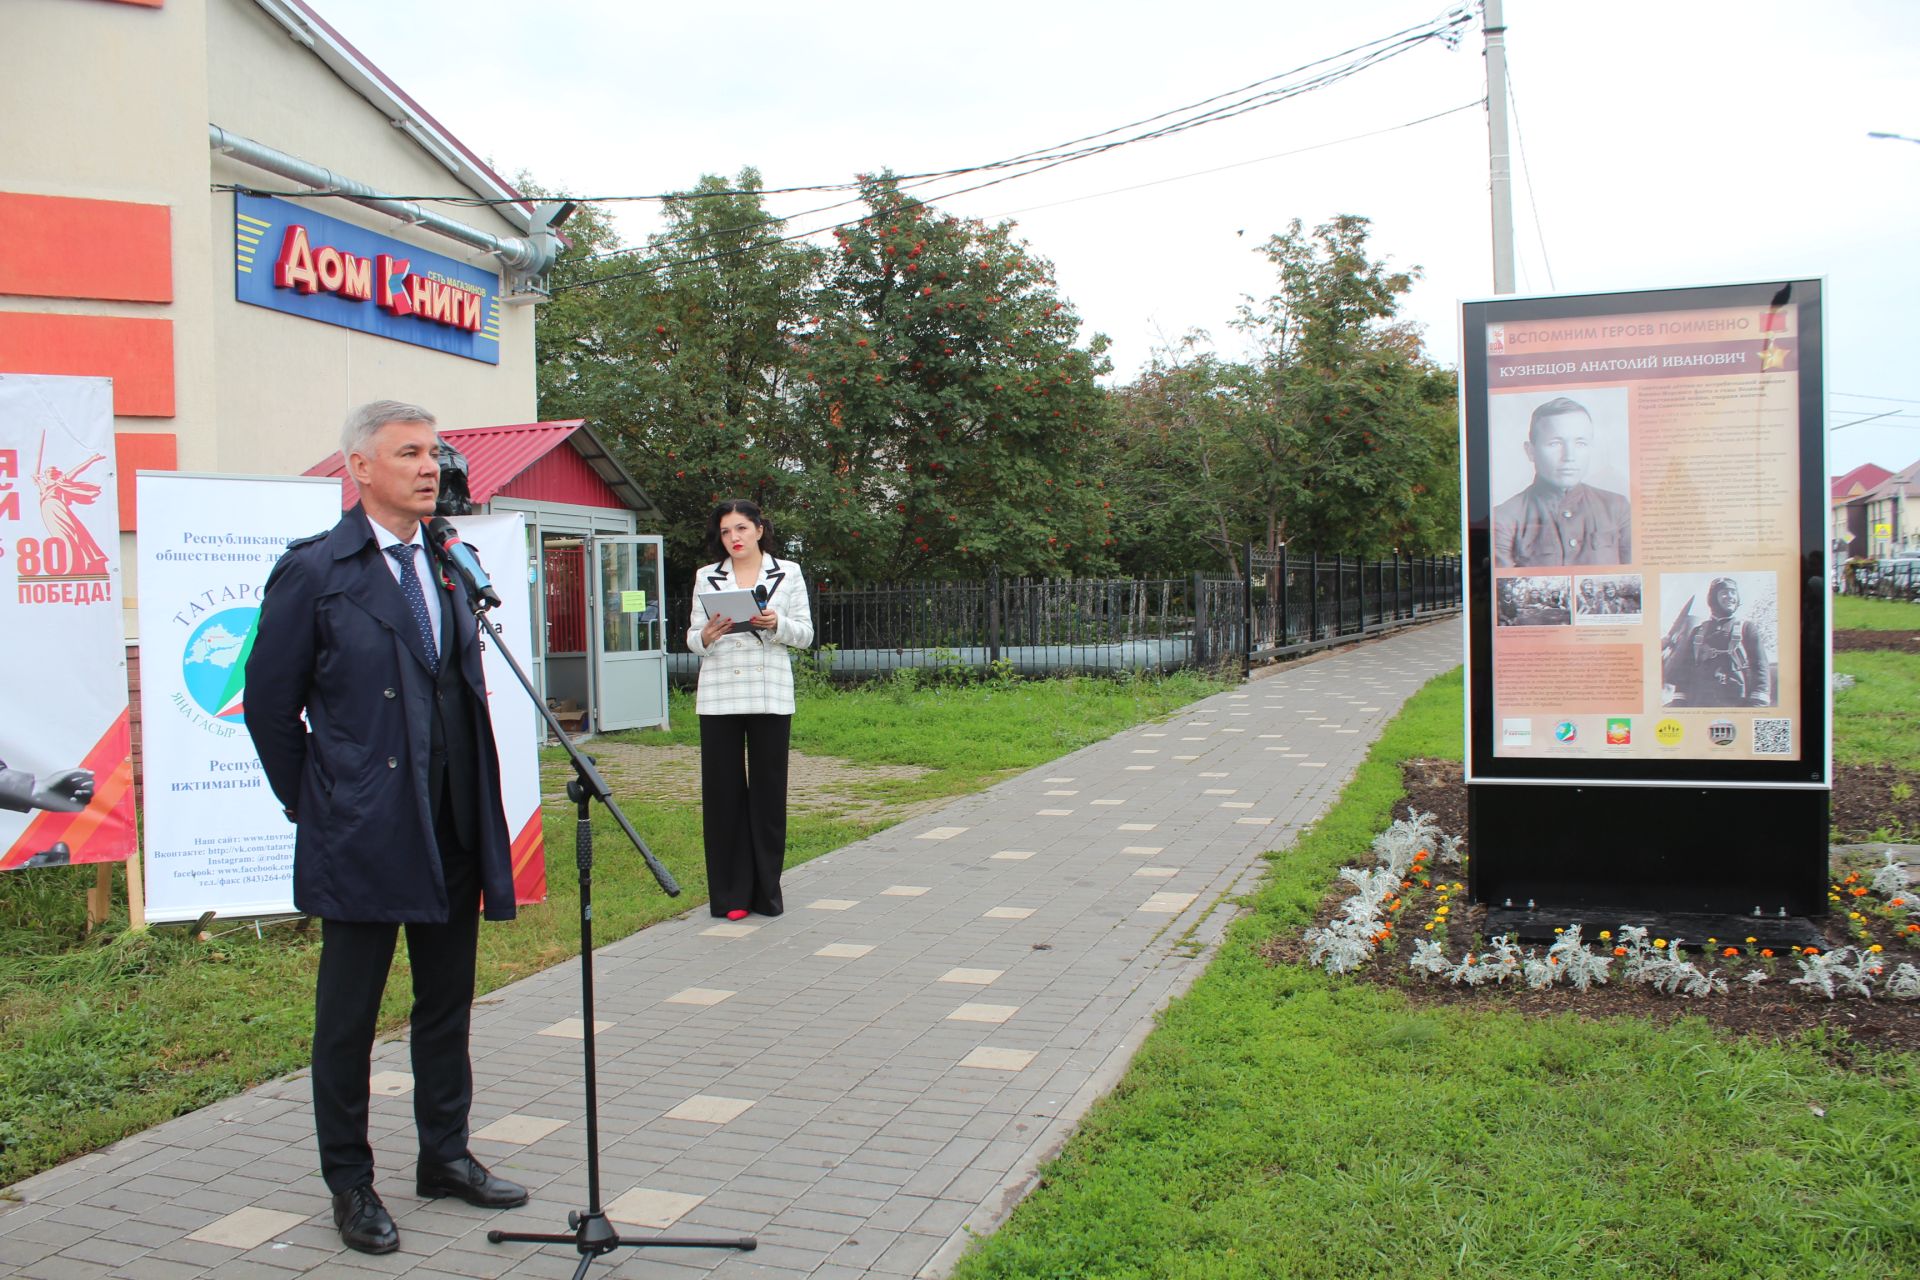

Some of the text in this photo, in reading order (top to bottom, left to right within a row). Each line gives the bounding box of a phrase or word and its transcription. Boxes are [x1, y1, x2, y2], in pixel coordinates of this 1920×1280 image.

[428, 271, 487, 298] СЕТЬ МАГАЗИНОВ
[1508, 317, 1749, 345] ВСПОМНИМ ГЕРОЕВ ПОИМЕННО
[1500, 352, 1746, 378] КУЗНЕЦОВ АНАТОЛИЙ ИВАНОВИЧ
[16, 537, 68, 576] 80
[155, 549, 262, 562] общественное
[18, 582, 112, 606] ПОБЕДА!
[154, 849, 206, 859] Вконтакте:
[208, 856, 255, 866] Instagram:
[173, 868, 215, 879] facebook:
